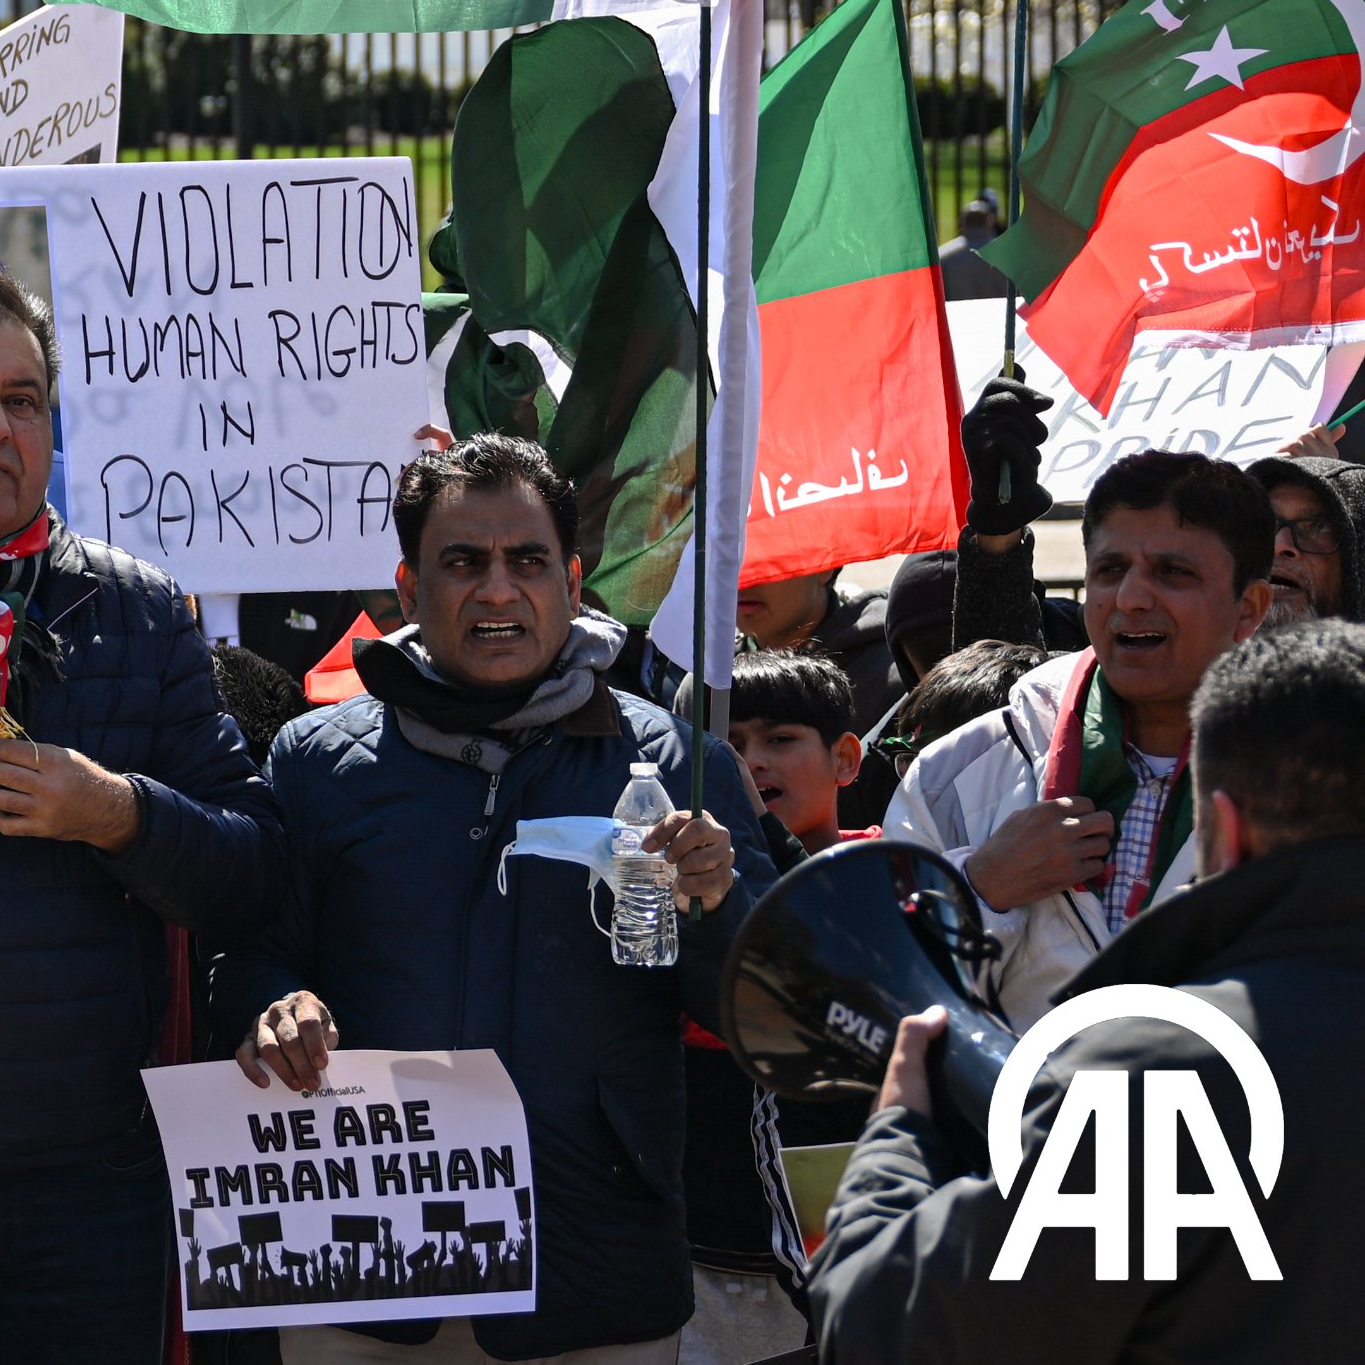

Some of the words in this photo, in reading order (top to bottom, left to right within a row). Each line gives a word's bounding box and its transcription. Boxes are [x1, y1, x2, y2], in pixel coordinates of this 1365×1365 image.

[90, 176, 413, 297] VIOLATION
[82, 314, 247, 385] HUMAN
[269, 301, 422, 379] RIGHTS
[201, 400, 255, 452] IN
[101, 453, 411, 556] PAKISTA
[826, 1000, 887, 1054] PYLE
[247, 1109, 321, 1153] WE
[333, 1099, 435, 1147] ARE
[185, 1156, 360, 1209] IMRAN
[372, 1145, 516, 1197] KHAN
